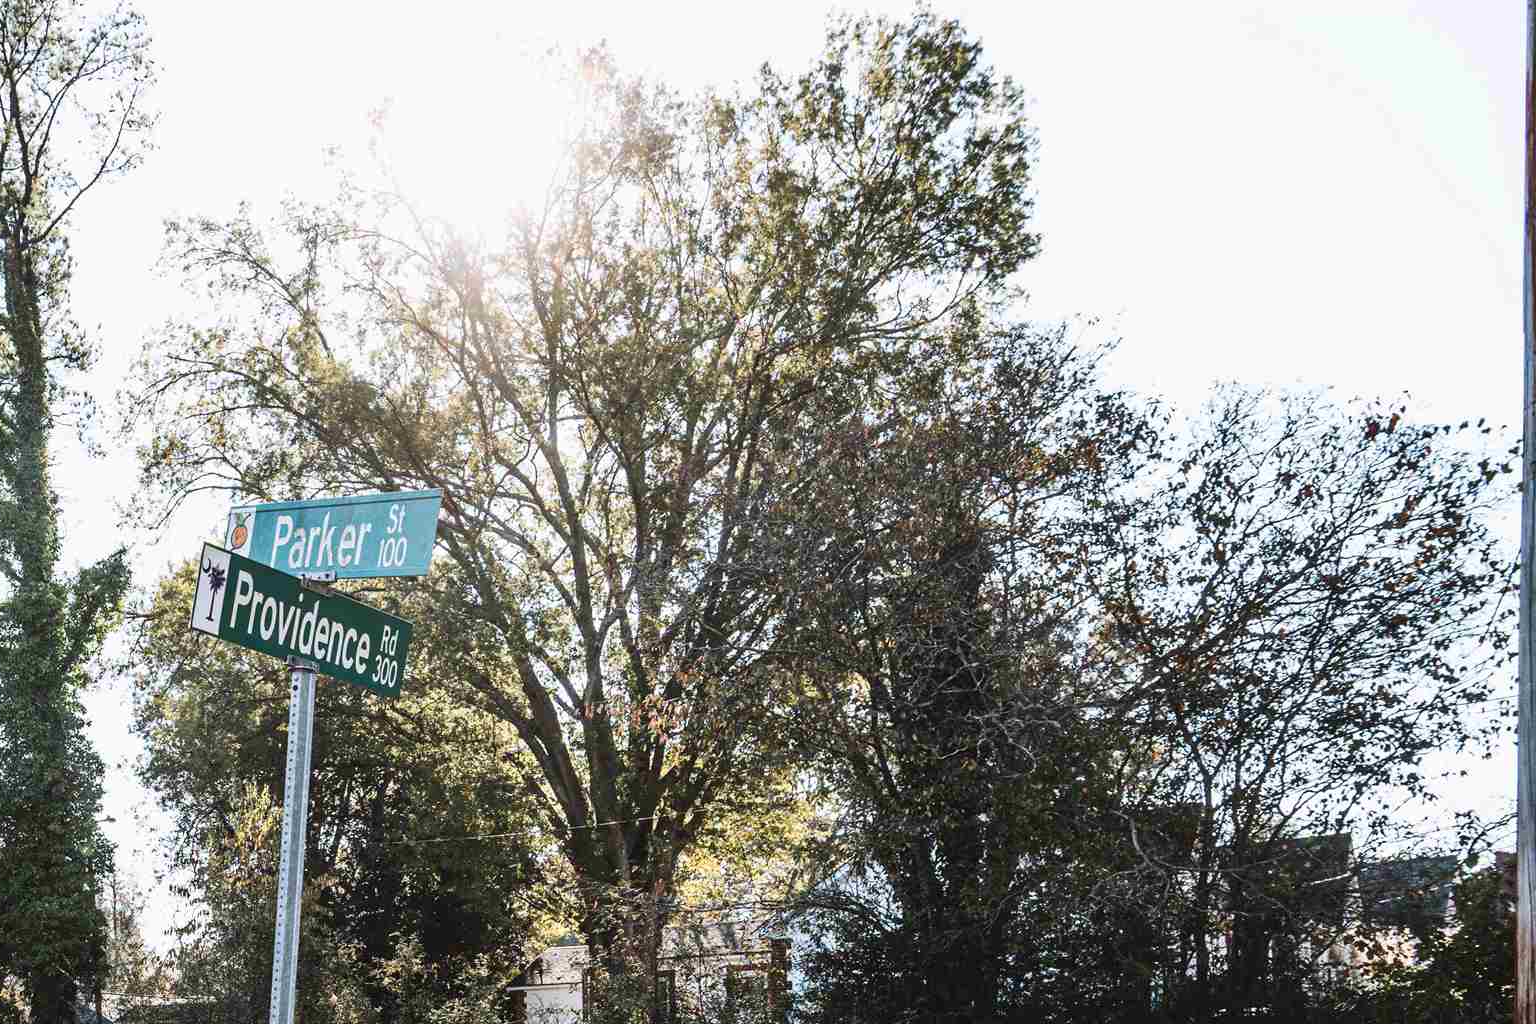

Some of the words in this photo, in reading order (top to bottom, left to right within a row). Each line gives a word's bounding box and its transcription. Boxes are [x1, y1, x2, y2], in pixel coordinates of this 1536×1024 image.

[271, 511, 371, 569] Parker
[387, 504, 406, 533] St
[377, 538, 407, 567] 100
[229, 570, 370, 674] Providence
[380, 624, 399, 655] Rd
[372, 656, 398, 688] 300
